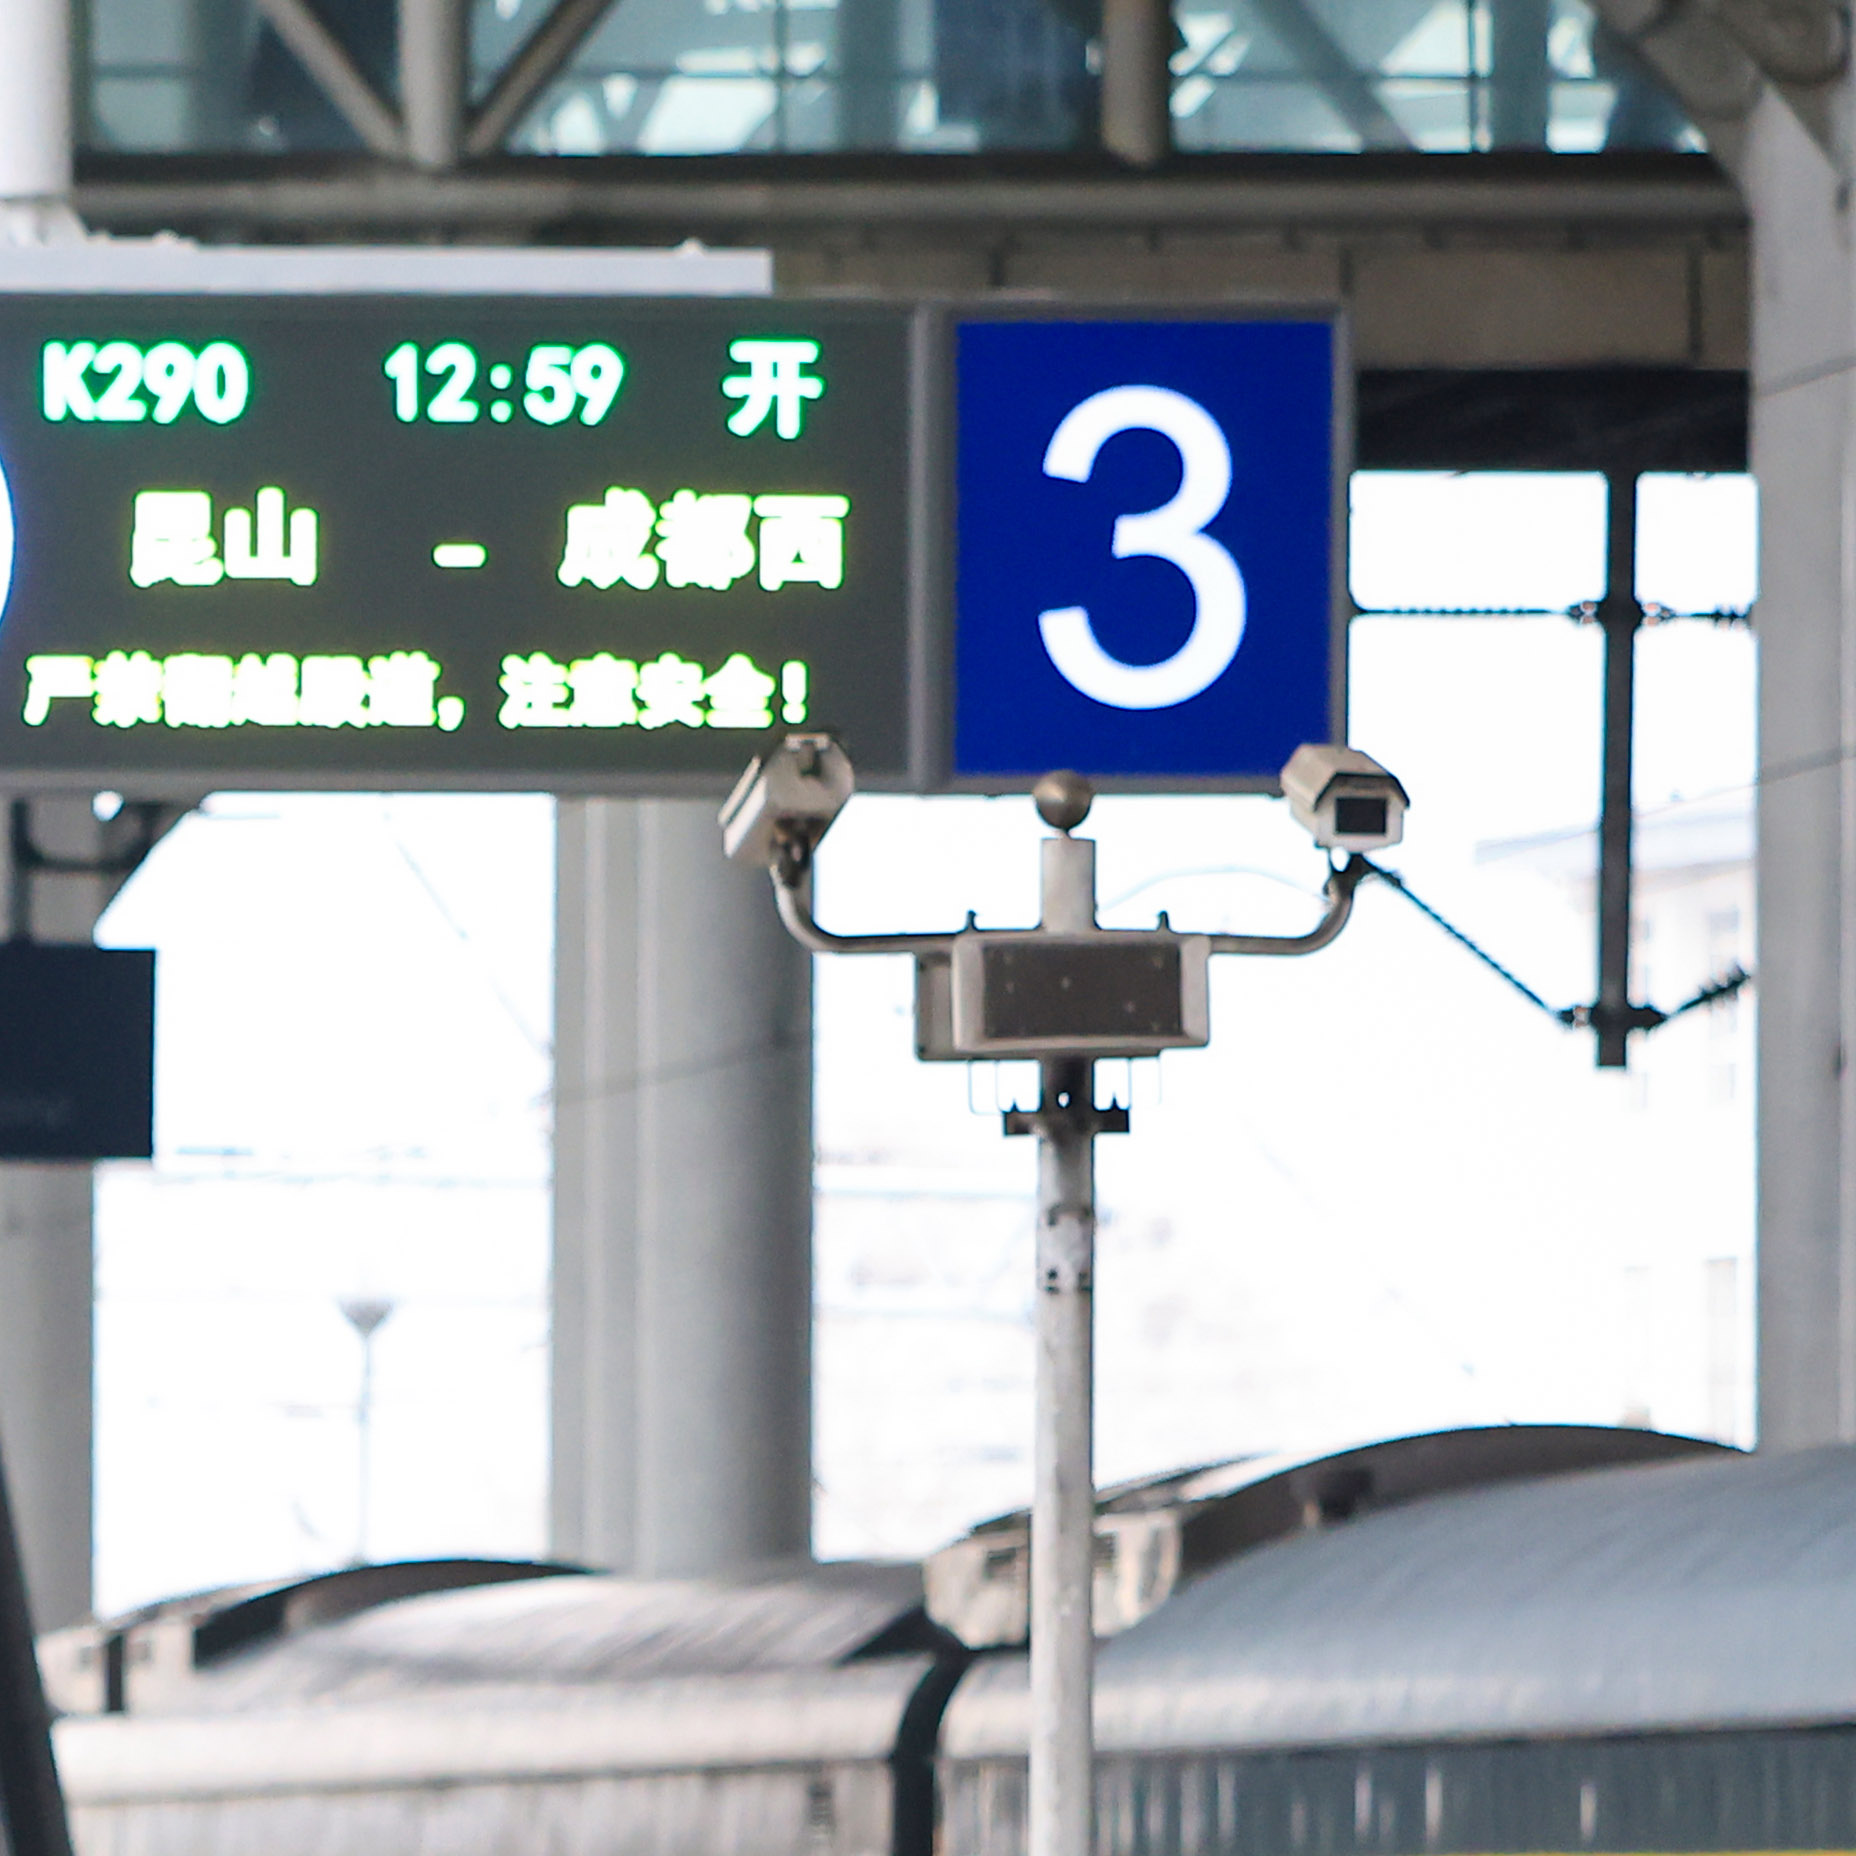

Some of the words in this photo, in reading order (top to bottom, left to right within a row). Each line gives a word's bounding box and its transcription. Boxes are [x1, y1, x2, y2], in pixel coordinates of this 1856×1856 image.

[41, 339, 251, 426] K290
[383, 340, 627, 427] 12:59
[721, 337, 826, 441] 开
[128, 485, 319, 589] 昆山
[556, 484, 851, 592] 成都西
[1038, 385, 1249, 714] 3
